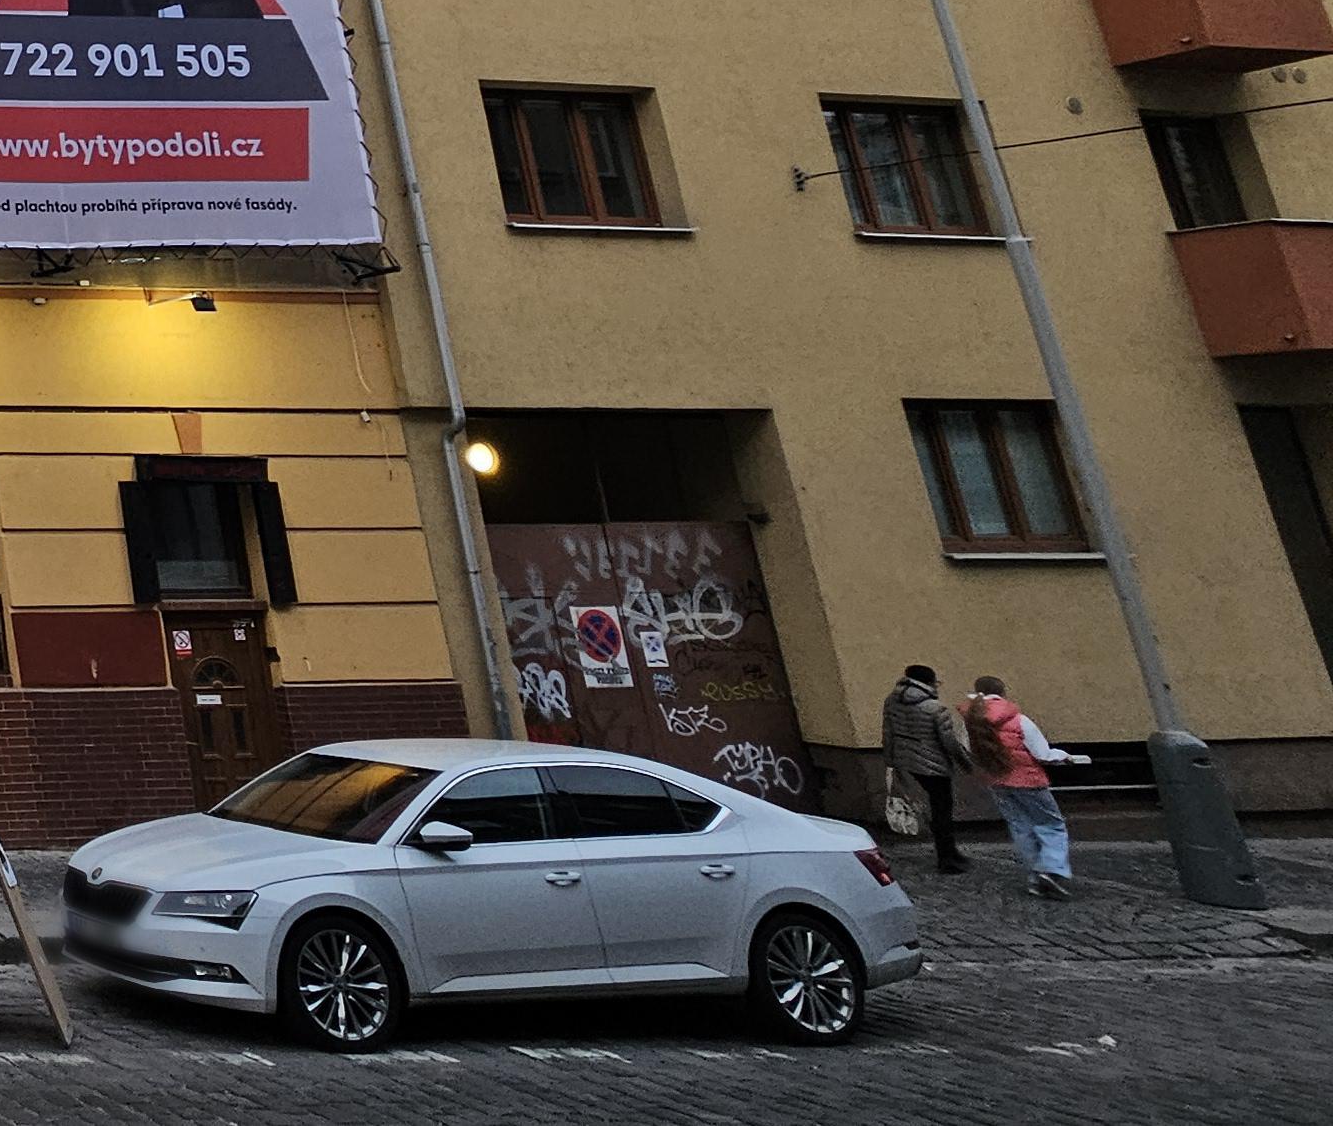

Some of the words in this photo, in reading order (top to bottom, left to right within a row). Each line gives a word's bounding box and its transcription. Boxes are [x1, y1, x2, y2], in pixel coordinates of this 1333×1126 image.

[0, 42, 78, 77] 722
[87, 43, 165, 78] 901
[176, 44, 252, 78] 505
[14, 198, 78, 215] plachtou
[80, 198, 138, 216] probíhá
[141, 197, 204, 215] příprava
[207, 197, 243, 212] nové
[244, 197, 298, 214] fasády.
